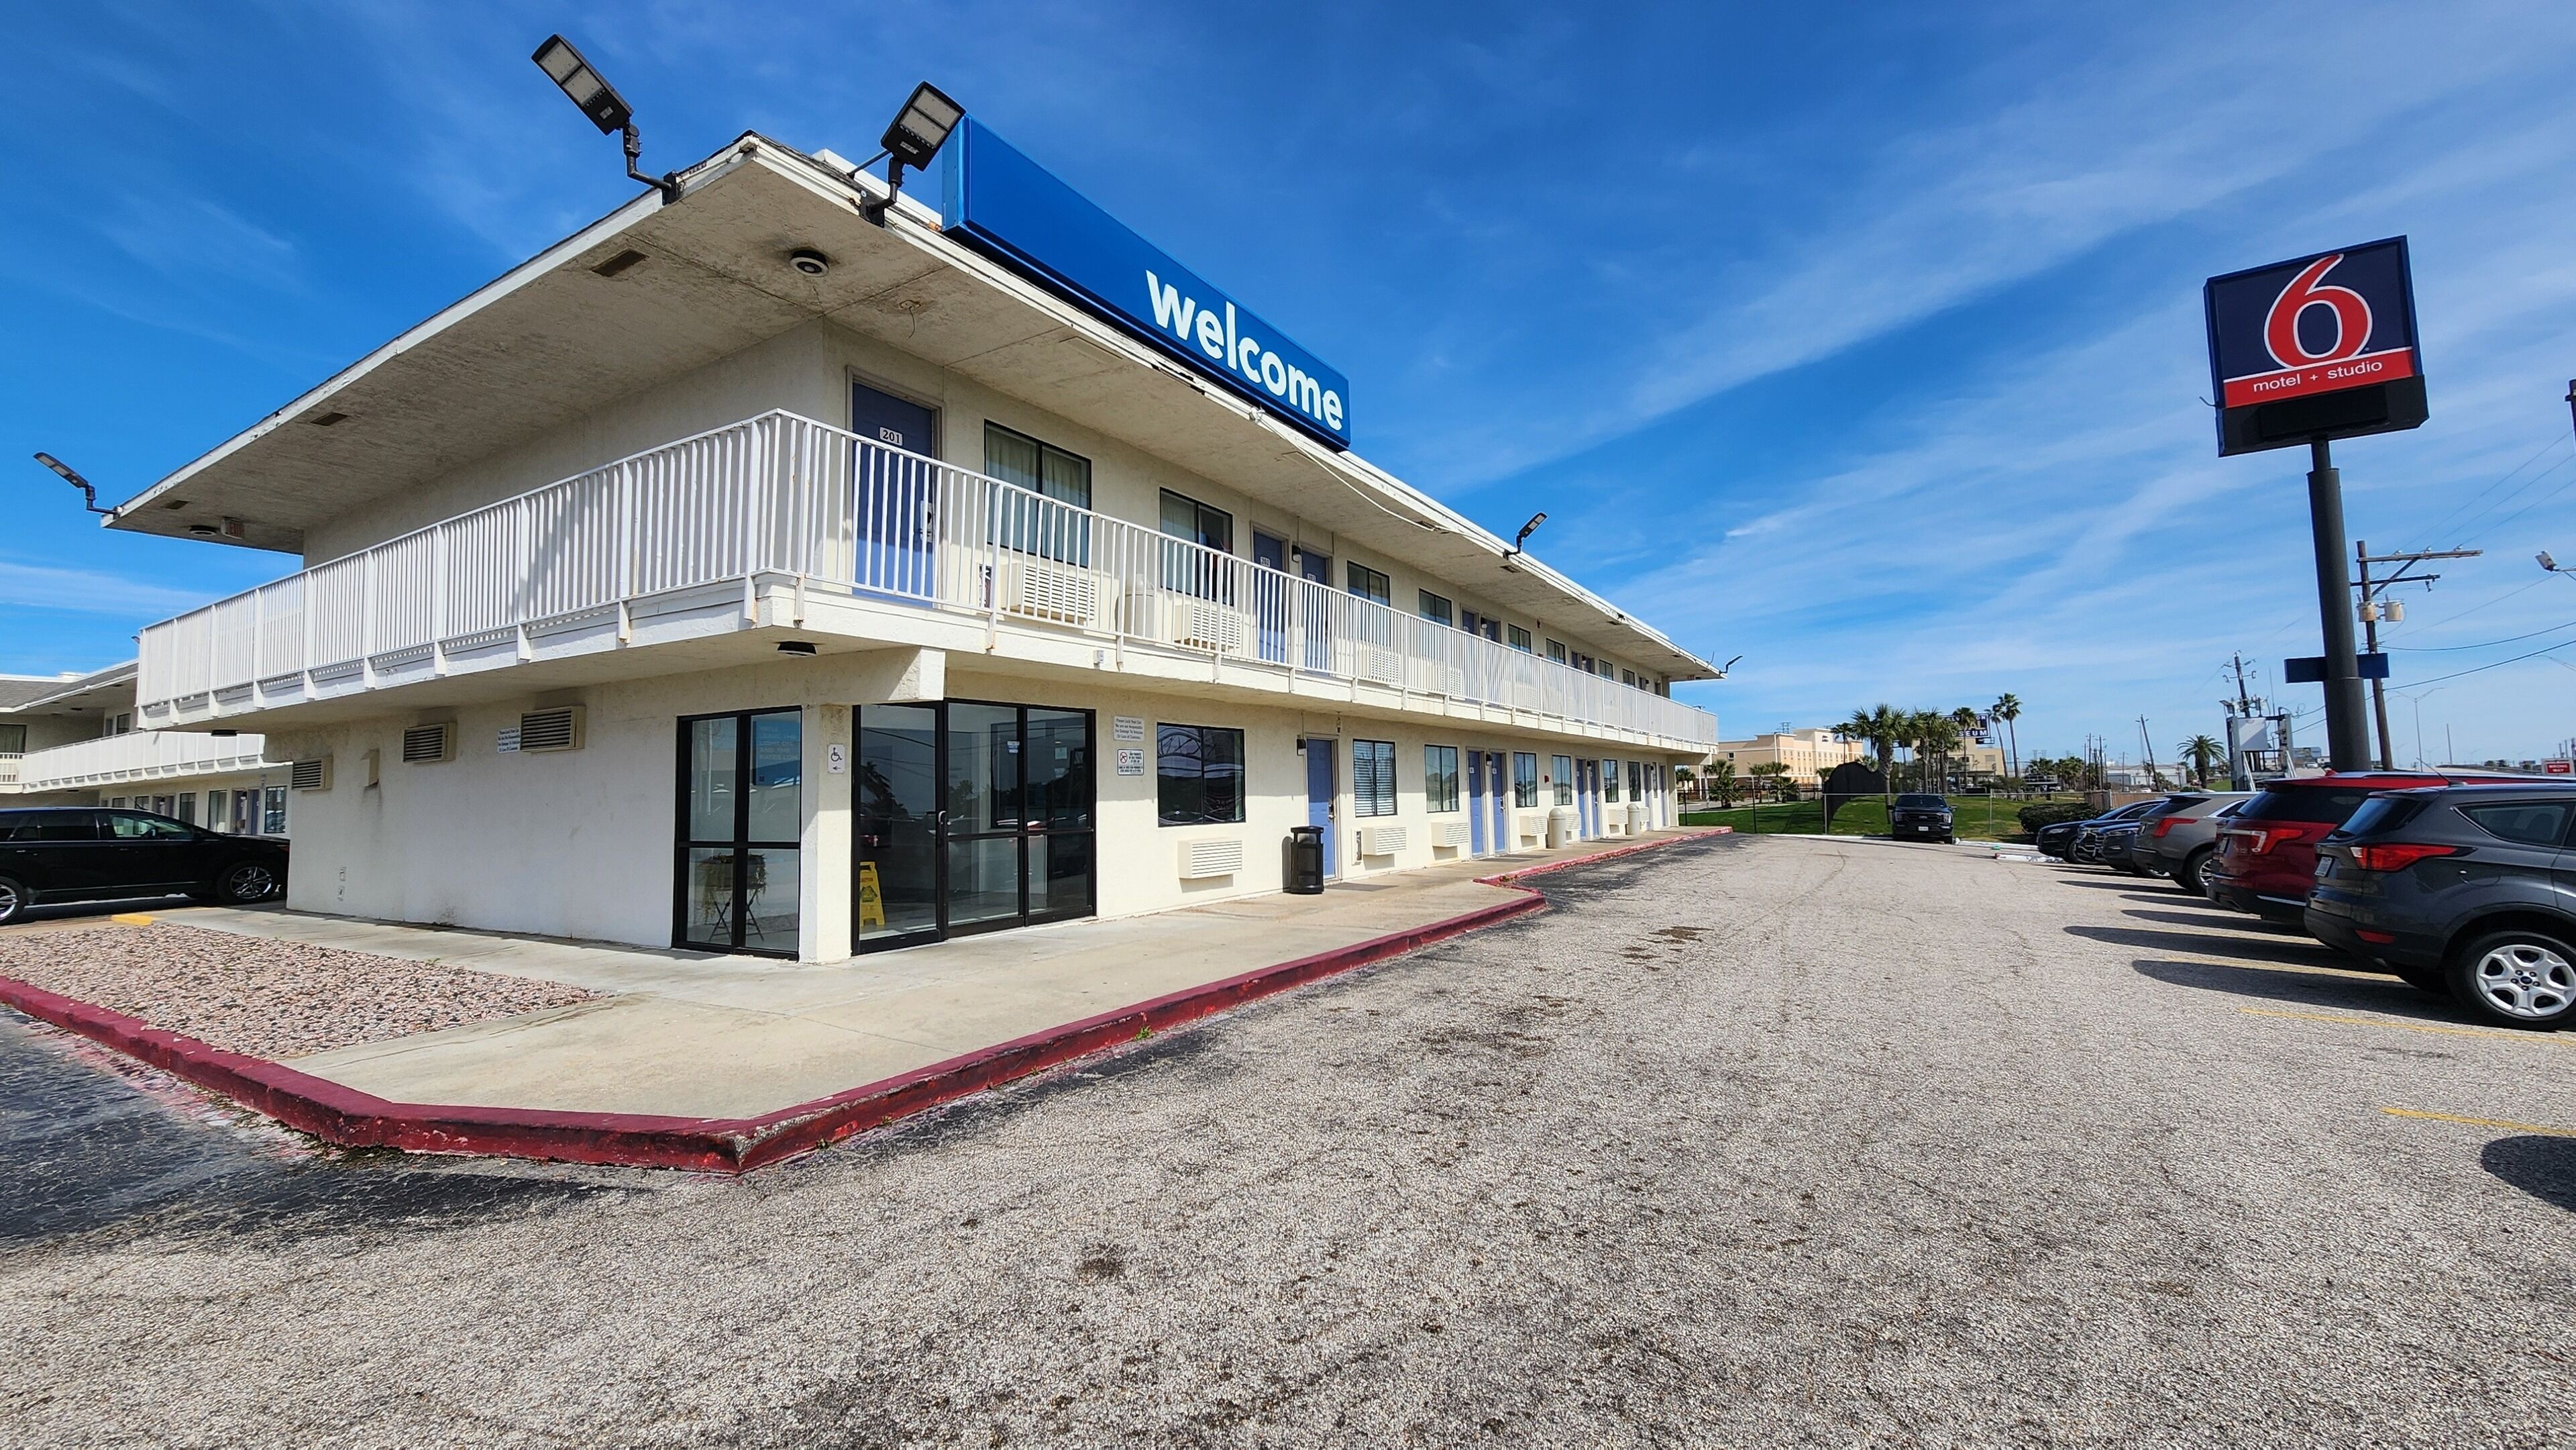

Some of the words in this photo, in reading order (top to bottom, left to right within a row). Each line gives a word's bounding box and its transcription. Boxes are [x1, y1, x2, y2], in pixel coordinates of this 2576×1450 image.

[2263, 253, 2373, 369] 6
[1146, 270, 1343, 431] welcome
[2253, 374, 2300, 392] motel
[2327, 361, 2383, 379] studio
[882, 429, 900, 444] 201
